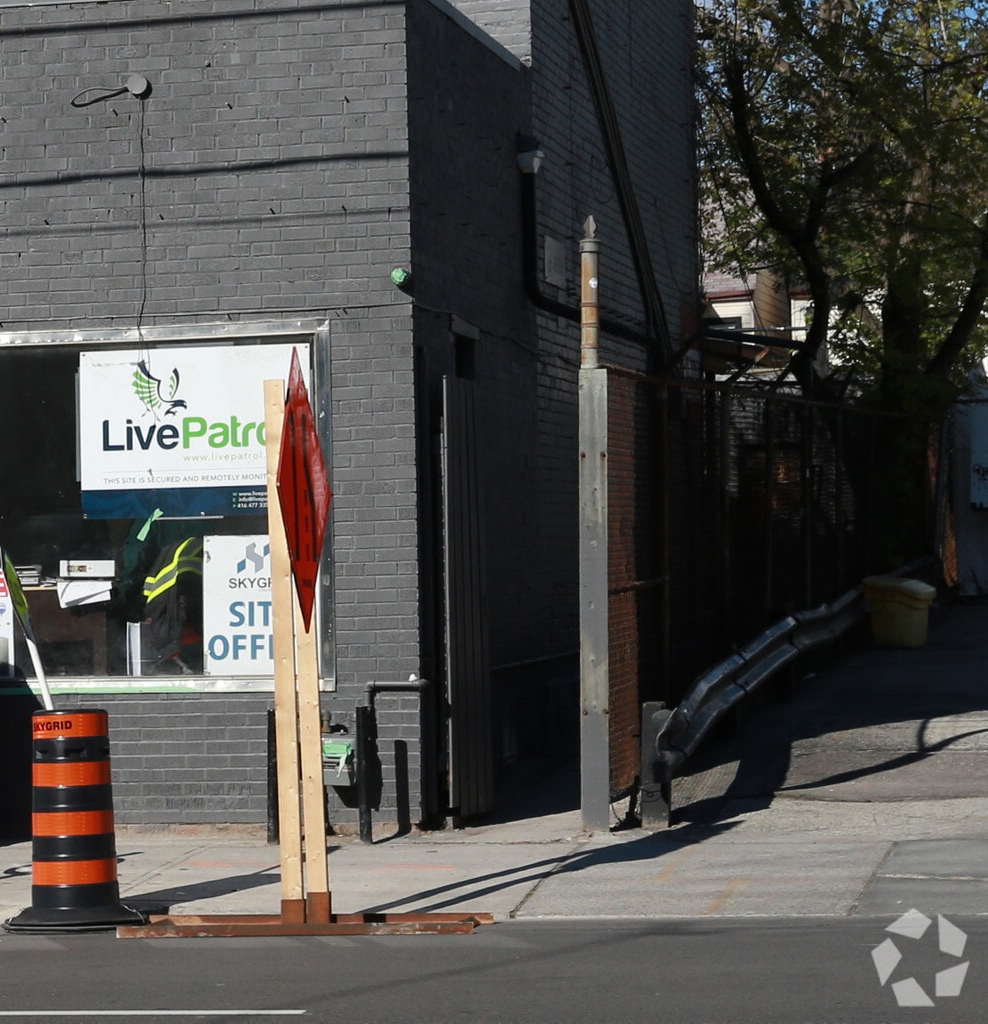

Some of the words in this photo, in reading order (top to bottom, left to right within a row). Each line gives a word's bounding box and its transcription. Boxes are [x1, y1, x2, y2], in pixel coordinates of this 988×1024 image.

[104, 476, 121, 484] THIS
[122, 476, 137, 484] SITE
[201, 474, 240, 482] REMOTELY
